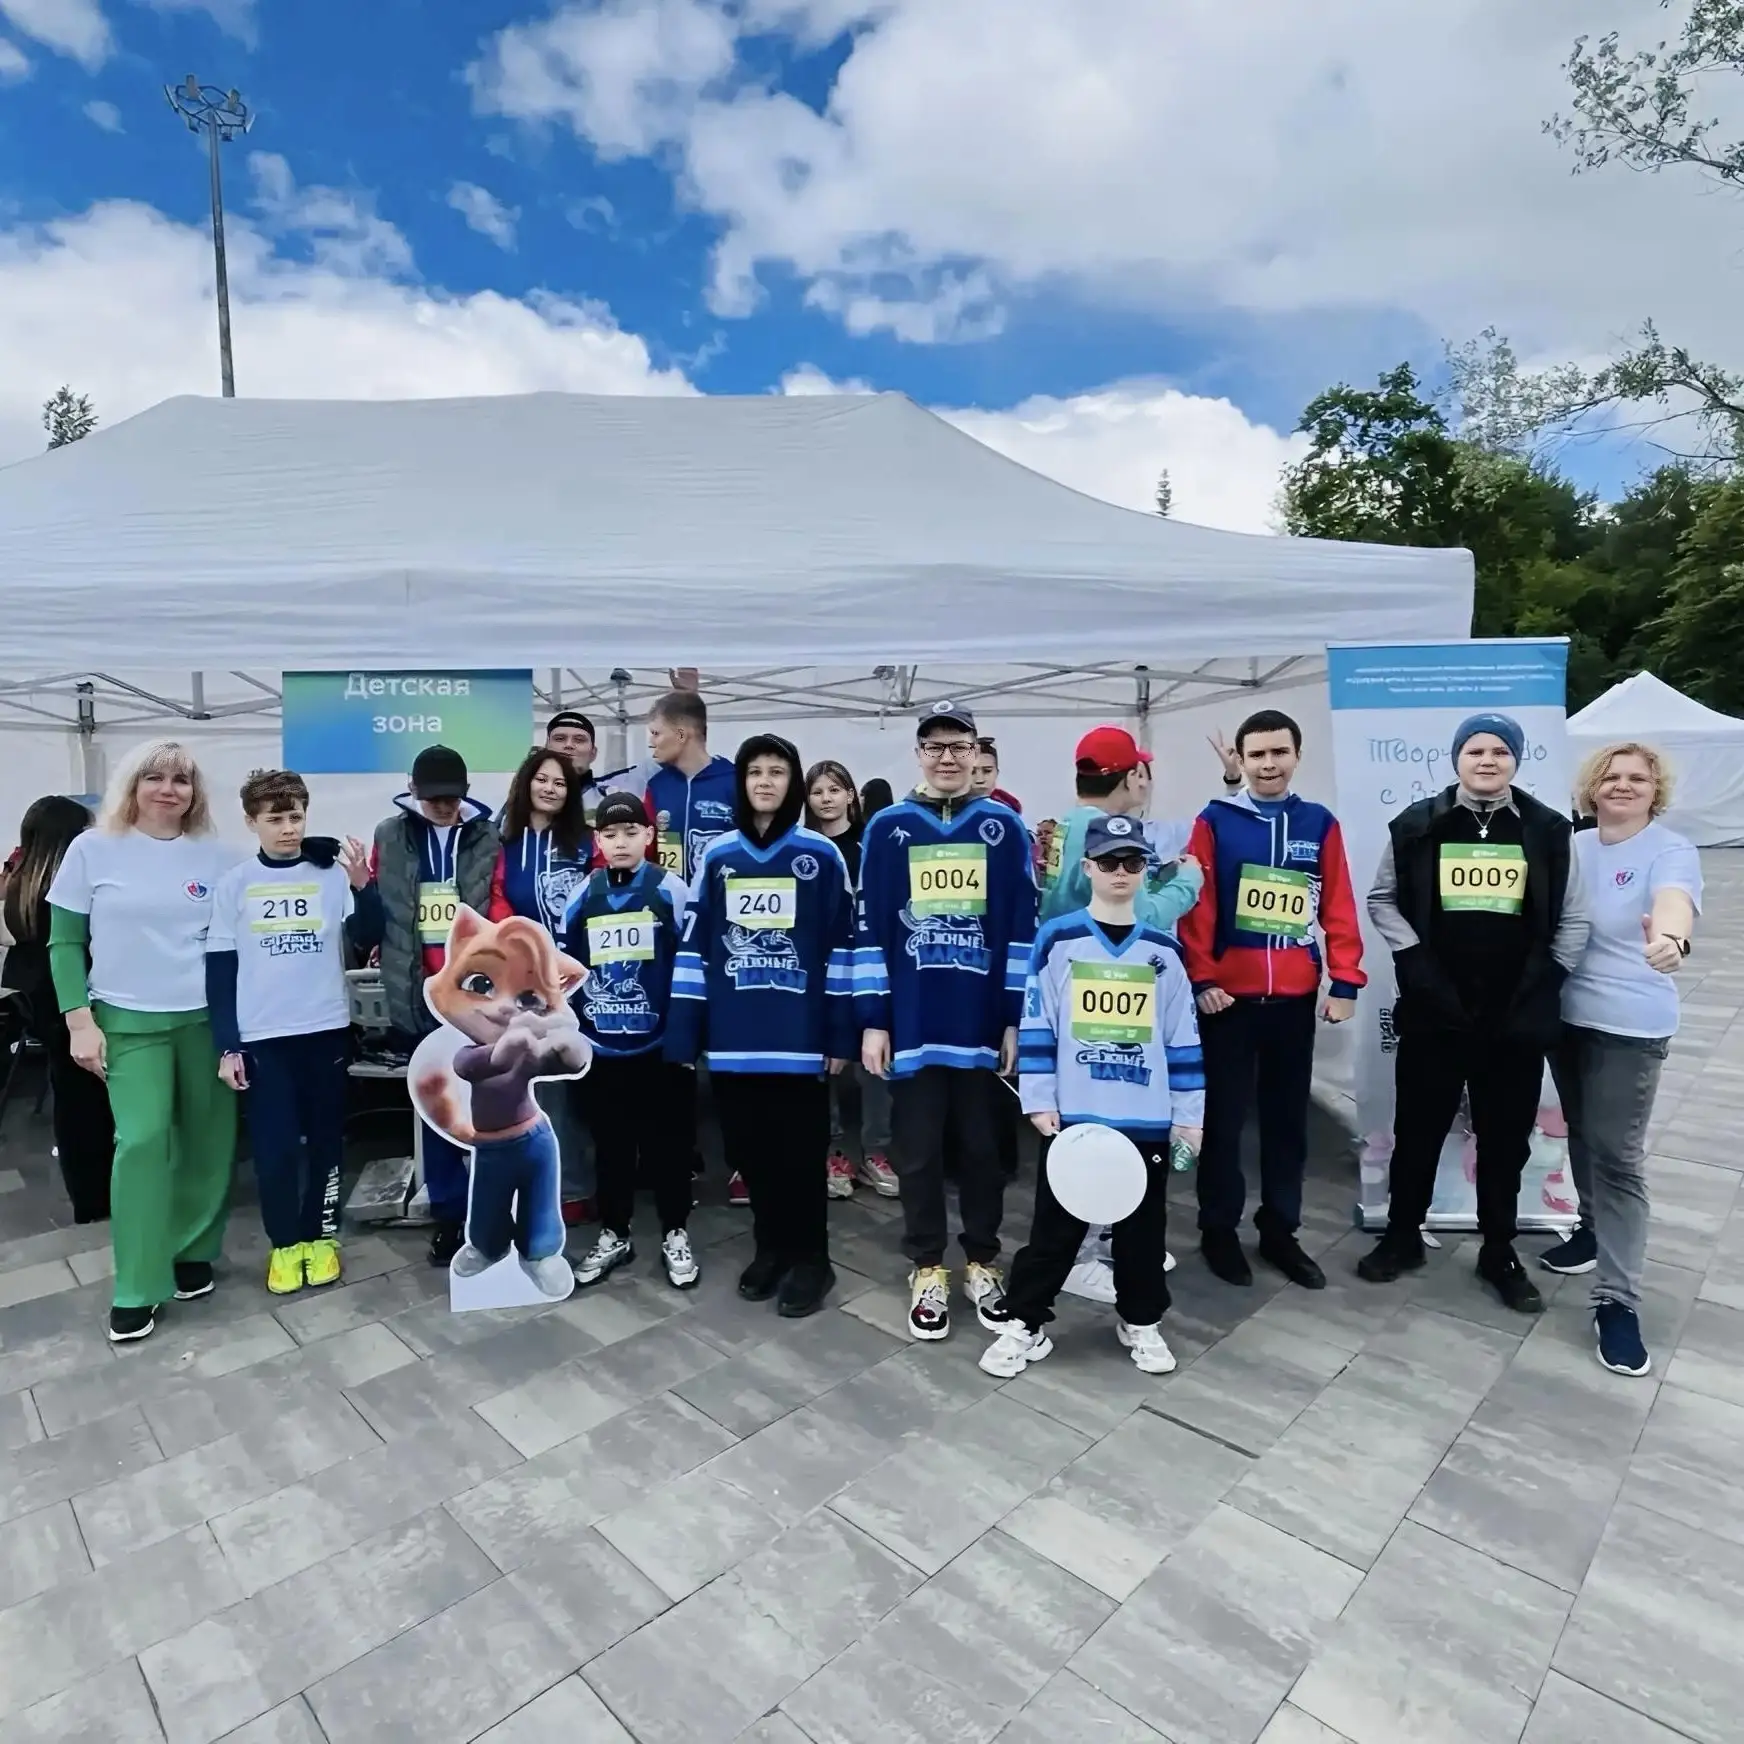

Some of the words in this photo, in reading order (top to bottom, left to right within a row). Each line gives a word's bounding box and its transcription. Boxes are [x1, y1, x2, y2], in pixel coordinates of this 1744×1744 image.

[344, 672, 471, 700] Детская
[372, 714, 443, 734] зона
[920, 868, 980, 891] 0004
[1451, 867, 1519, 889] 0009
[262, 898, 308, 919] 218
[739, 893, 782, 915] 240
[1246, 888, 1305, 915] 0010
[599, 927, 641, 949] 210
[1082, 990, 1148, 1016] 0007
